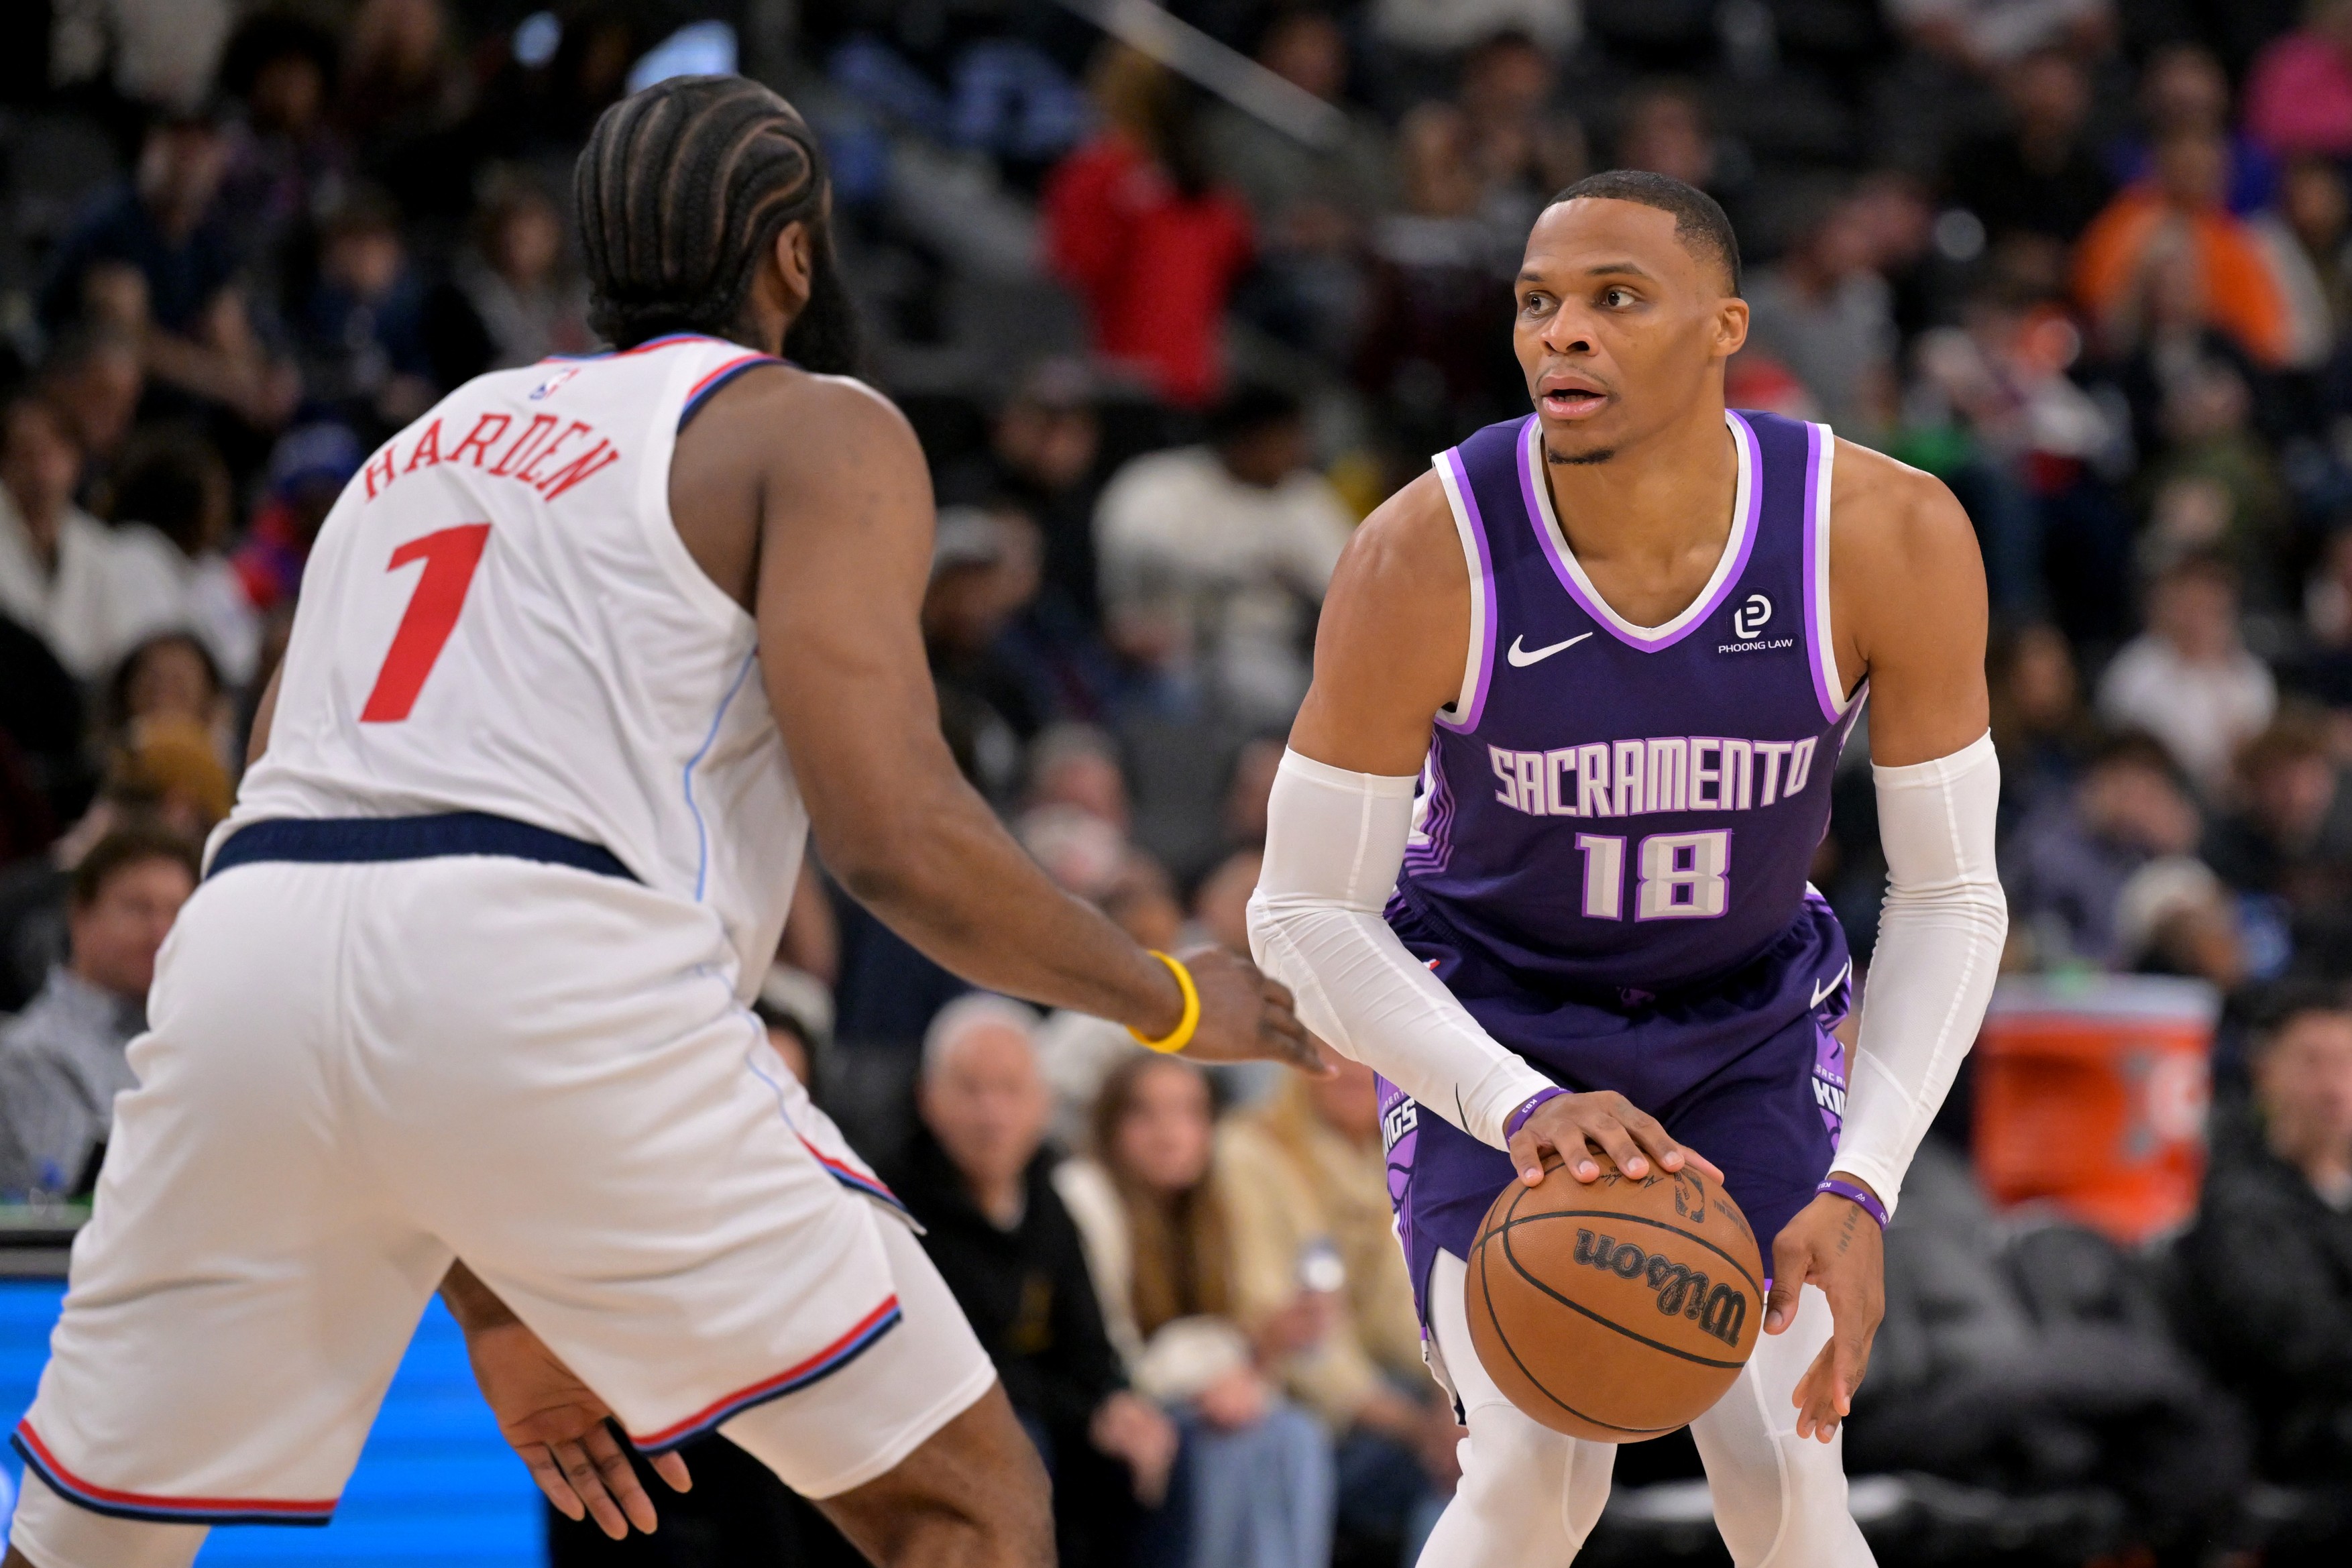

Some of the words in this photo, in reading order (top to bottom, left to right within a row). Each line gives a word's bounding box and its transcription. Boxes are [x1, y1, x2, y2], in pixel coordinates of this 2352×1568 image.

[366, 412, 619, 503] HARDEN
[359, 522, 492, 724] 1
[1718, 641, 1767, 654] PHOONG
[1768, 638, 1793, 649] LAW
[1488, 736, 1818, 818] SACRAMENTO
[1574, 828, 1735, 923] 18
[1382, 1097, 1418, 1159] NGS
[1521, 1099, 1538, 1113] KB3
[1573, 1228, 1746, 1348] Wilson
